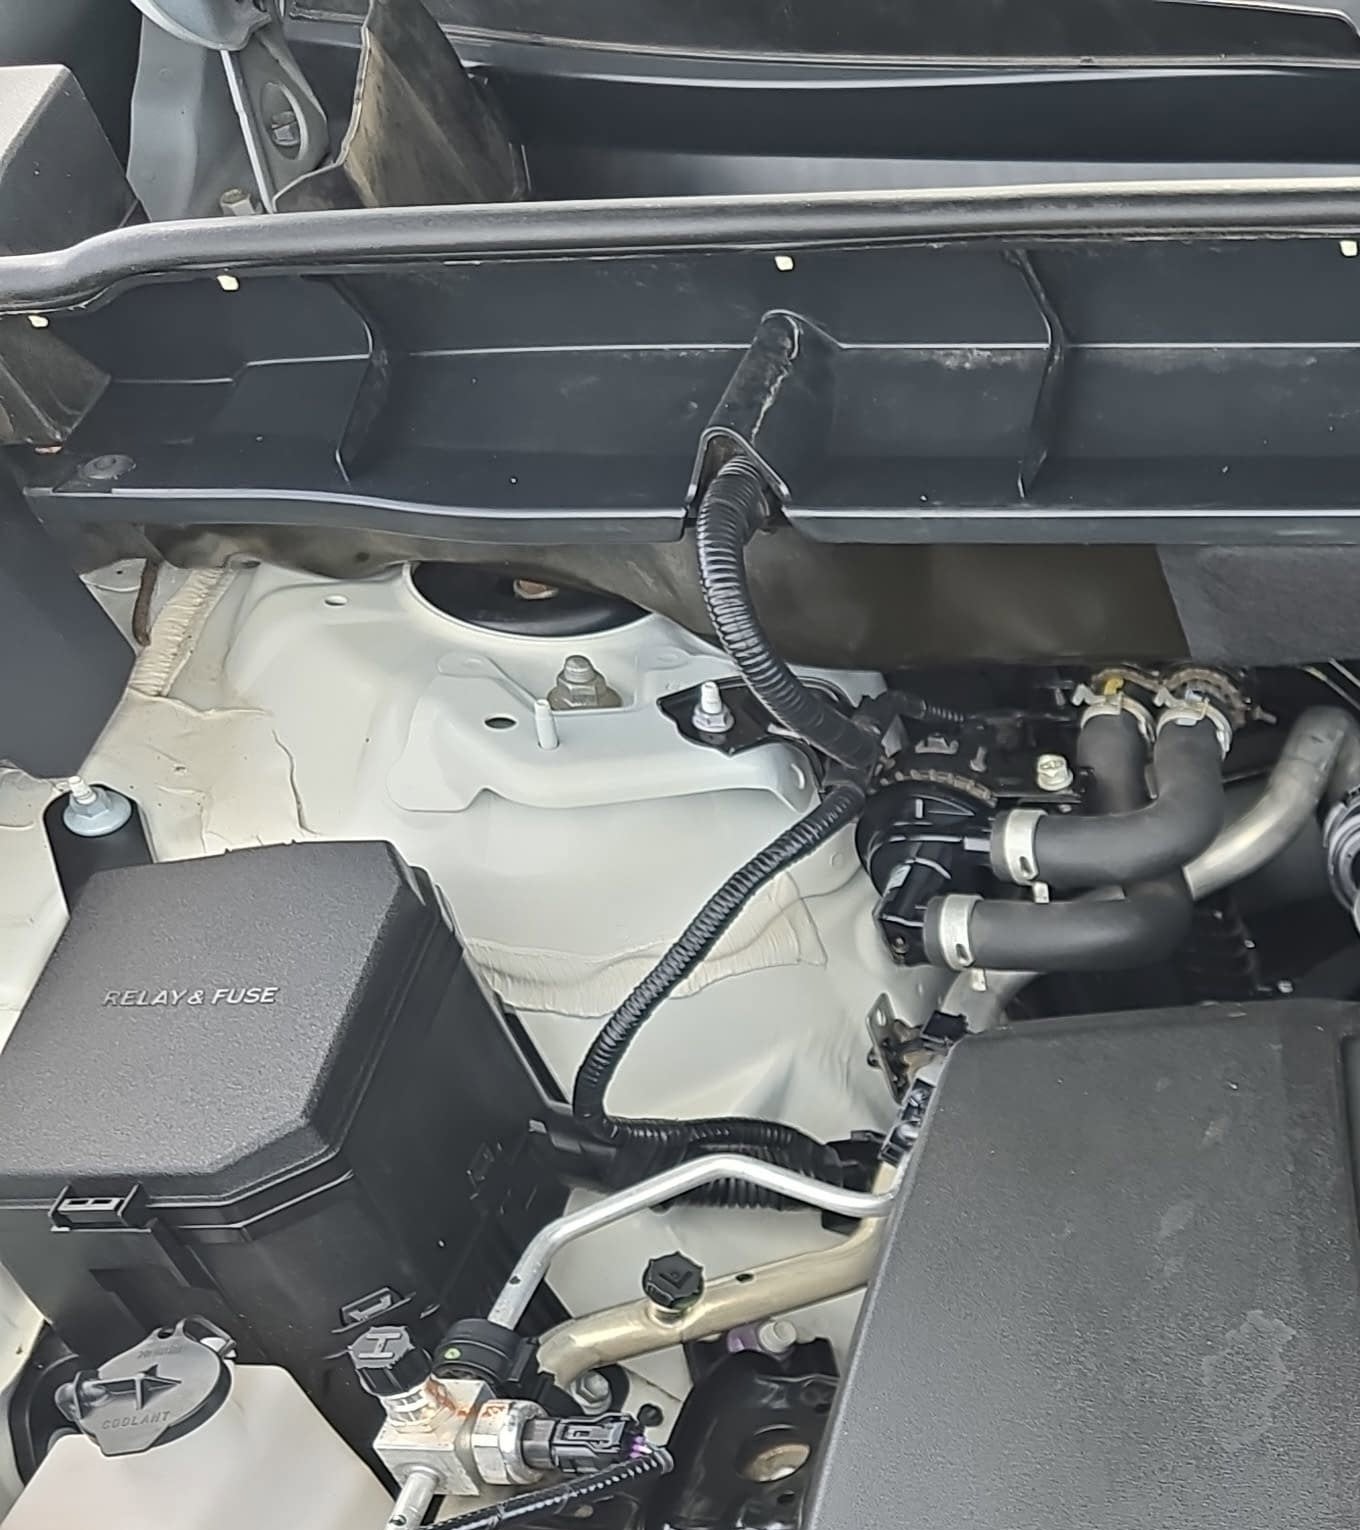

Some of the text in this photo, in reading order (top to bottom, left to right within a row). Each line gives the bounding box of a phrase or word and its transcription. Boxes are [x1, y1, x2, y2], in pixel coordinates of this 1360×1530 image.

[102, 987, 279, 1006] RELAY & FUSE
[102, 1411, 171, 1430] COOLANT
